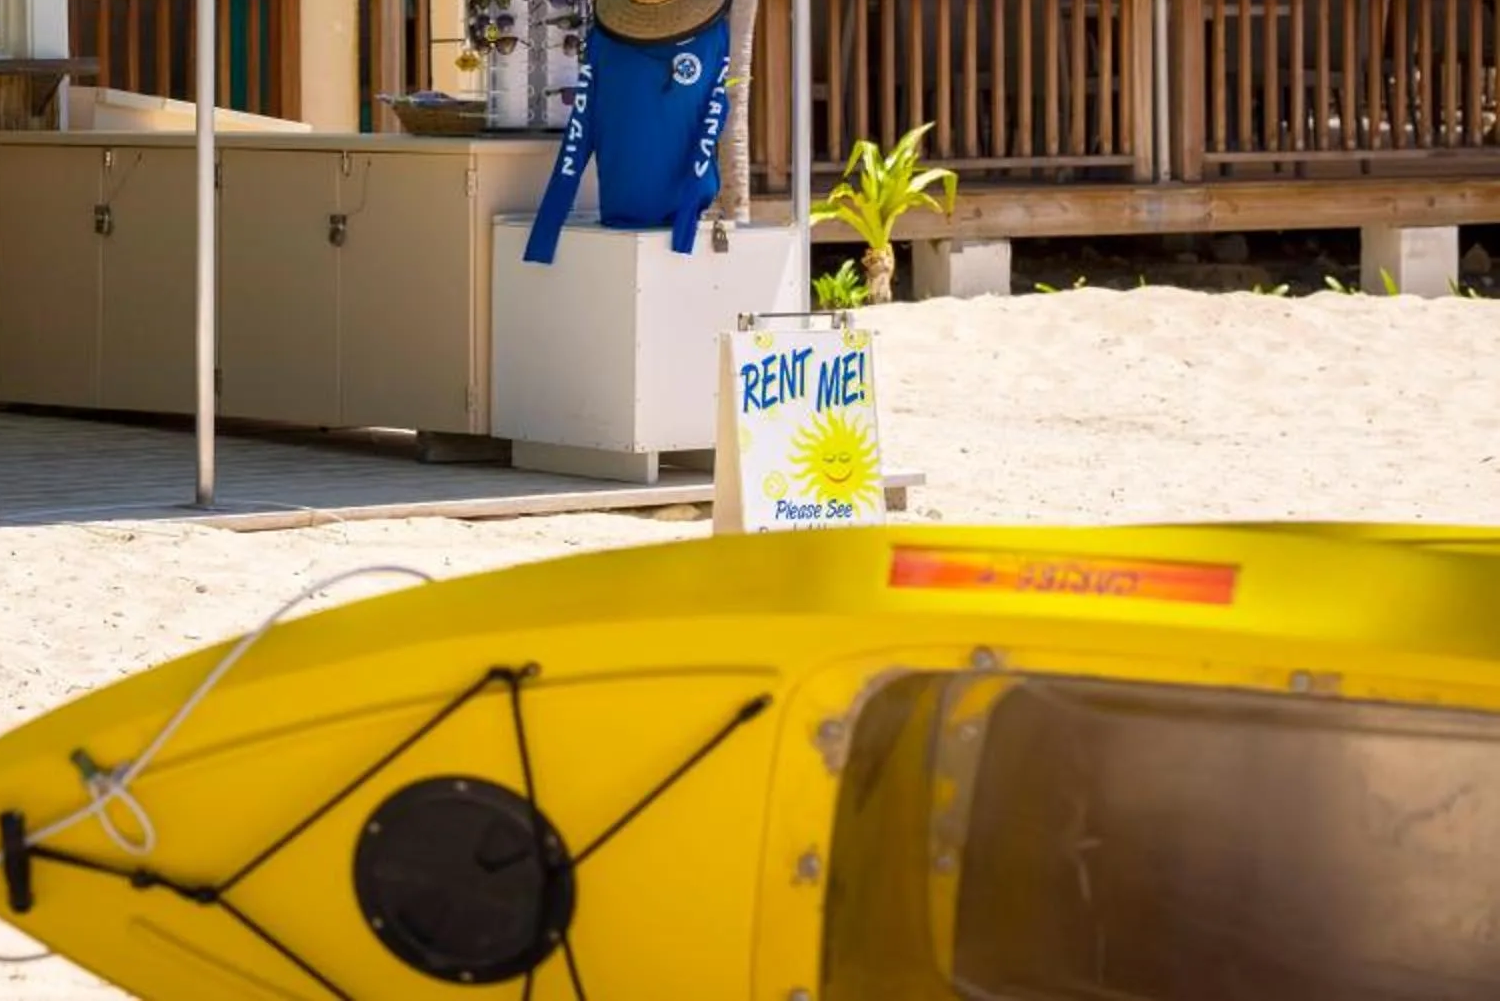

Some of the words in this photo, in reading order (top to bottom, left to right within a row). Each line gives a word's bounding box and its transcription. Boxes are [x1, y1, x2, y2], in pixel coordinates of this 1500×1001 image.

[740, 347, 813, 414] RENT
[816, 351, 866, 413] ME!
[775, 499, 822, 520] Please
[825, 498, 853, 519] See
